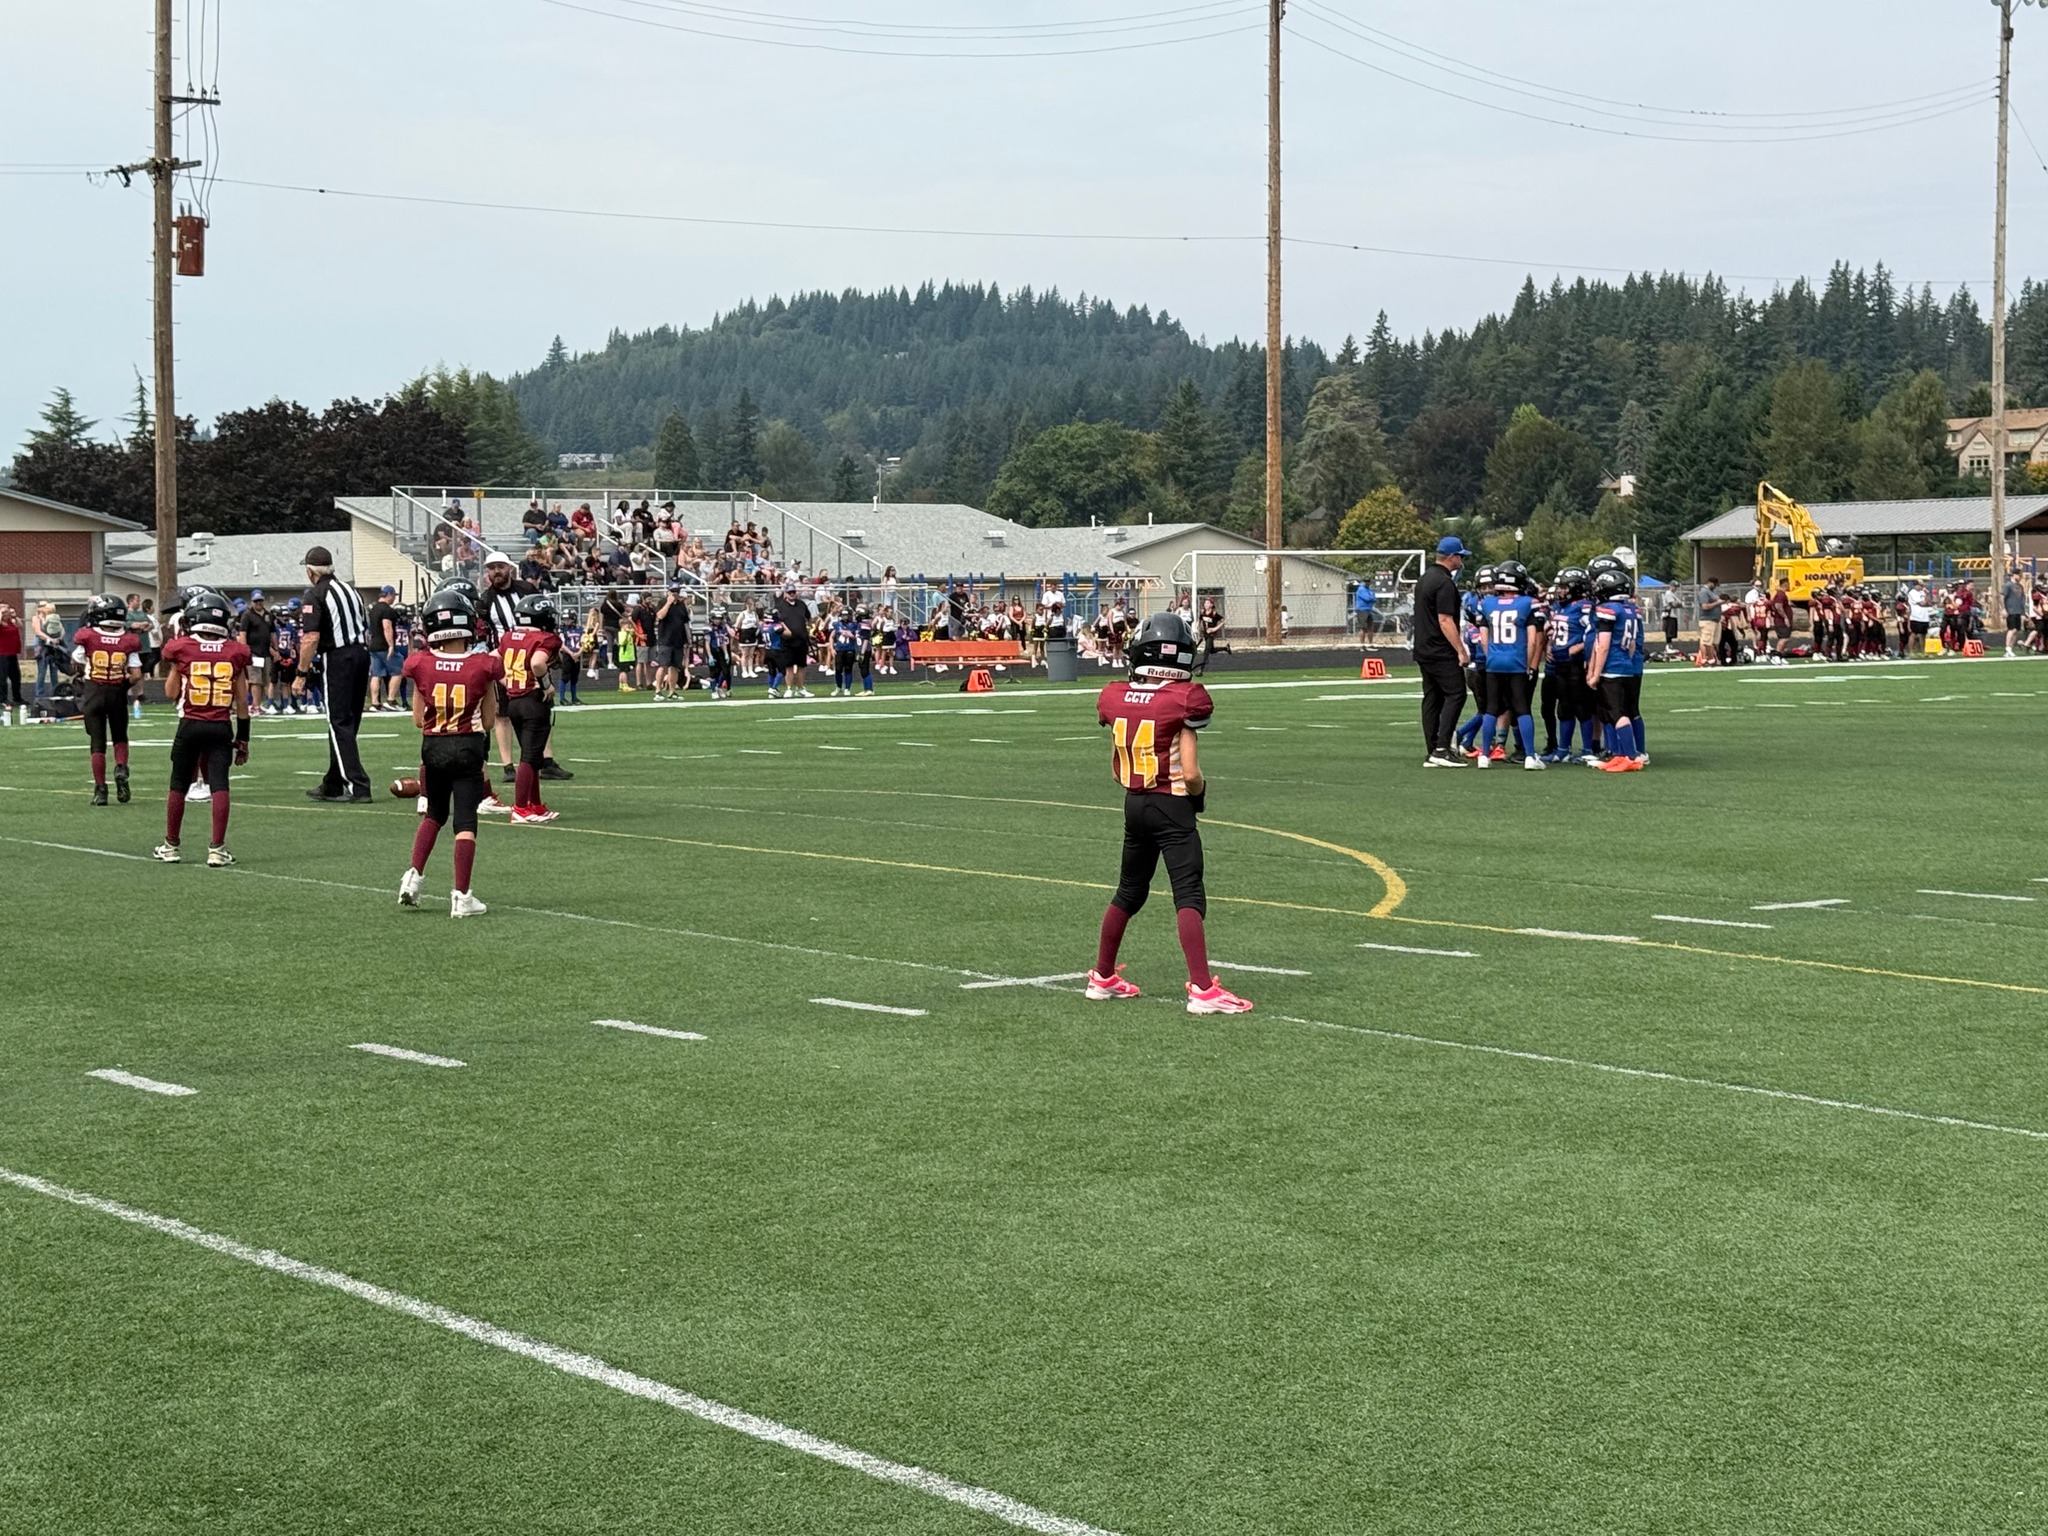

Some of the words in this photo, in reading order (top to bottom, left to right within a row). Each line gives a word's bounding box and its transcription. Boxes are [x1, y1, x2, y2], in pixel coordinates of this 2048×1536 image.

[1489, 609, 1519, 645] 16
[199, 642, 223, 653] CCYF
[1967, 641, 1984, 656] 30
[435, 659, 464, 672] CCYF
[1147, 667, 1183, 679] Riddell
[1367, 660, 1384, 676] 50
[188, 661, 234, 707] 52
[977, 672, 994, 688] 40
[1123, 690, 1155, 704] CCYF
[431, 682, 466, 734] 11
[1112, 716, 1159, 790] 14
